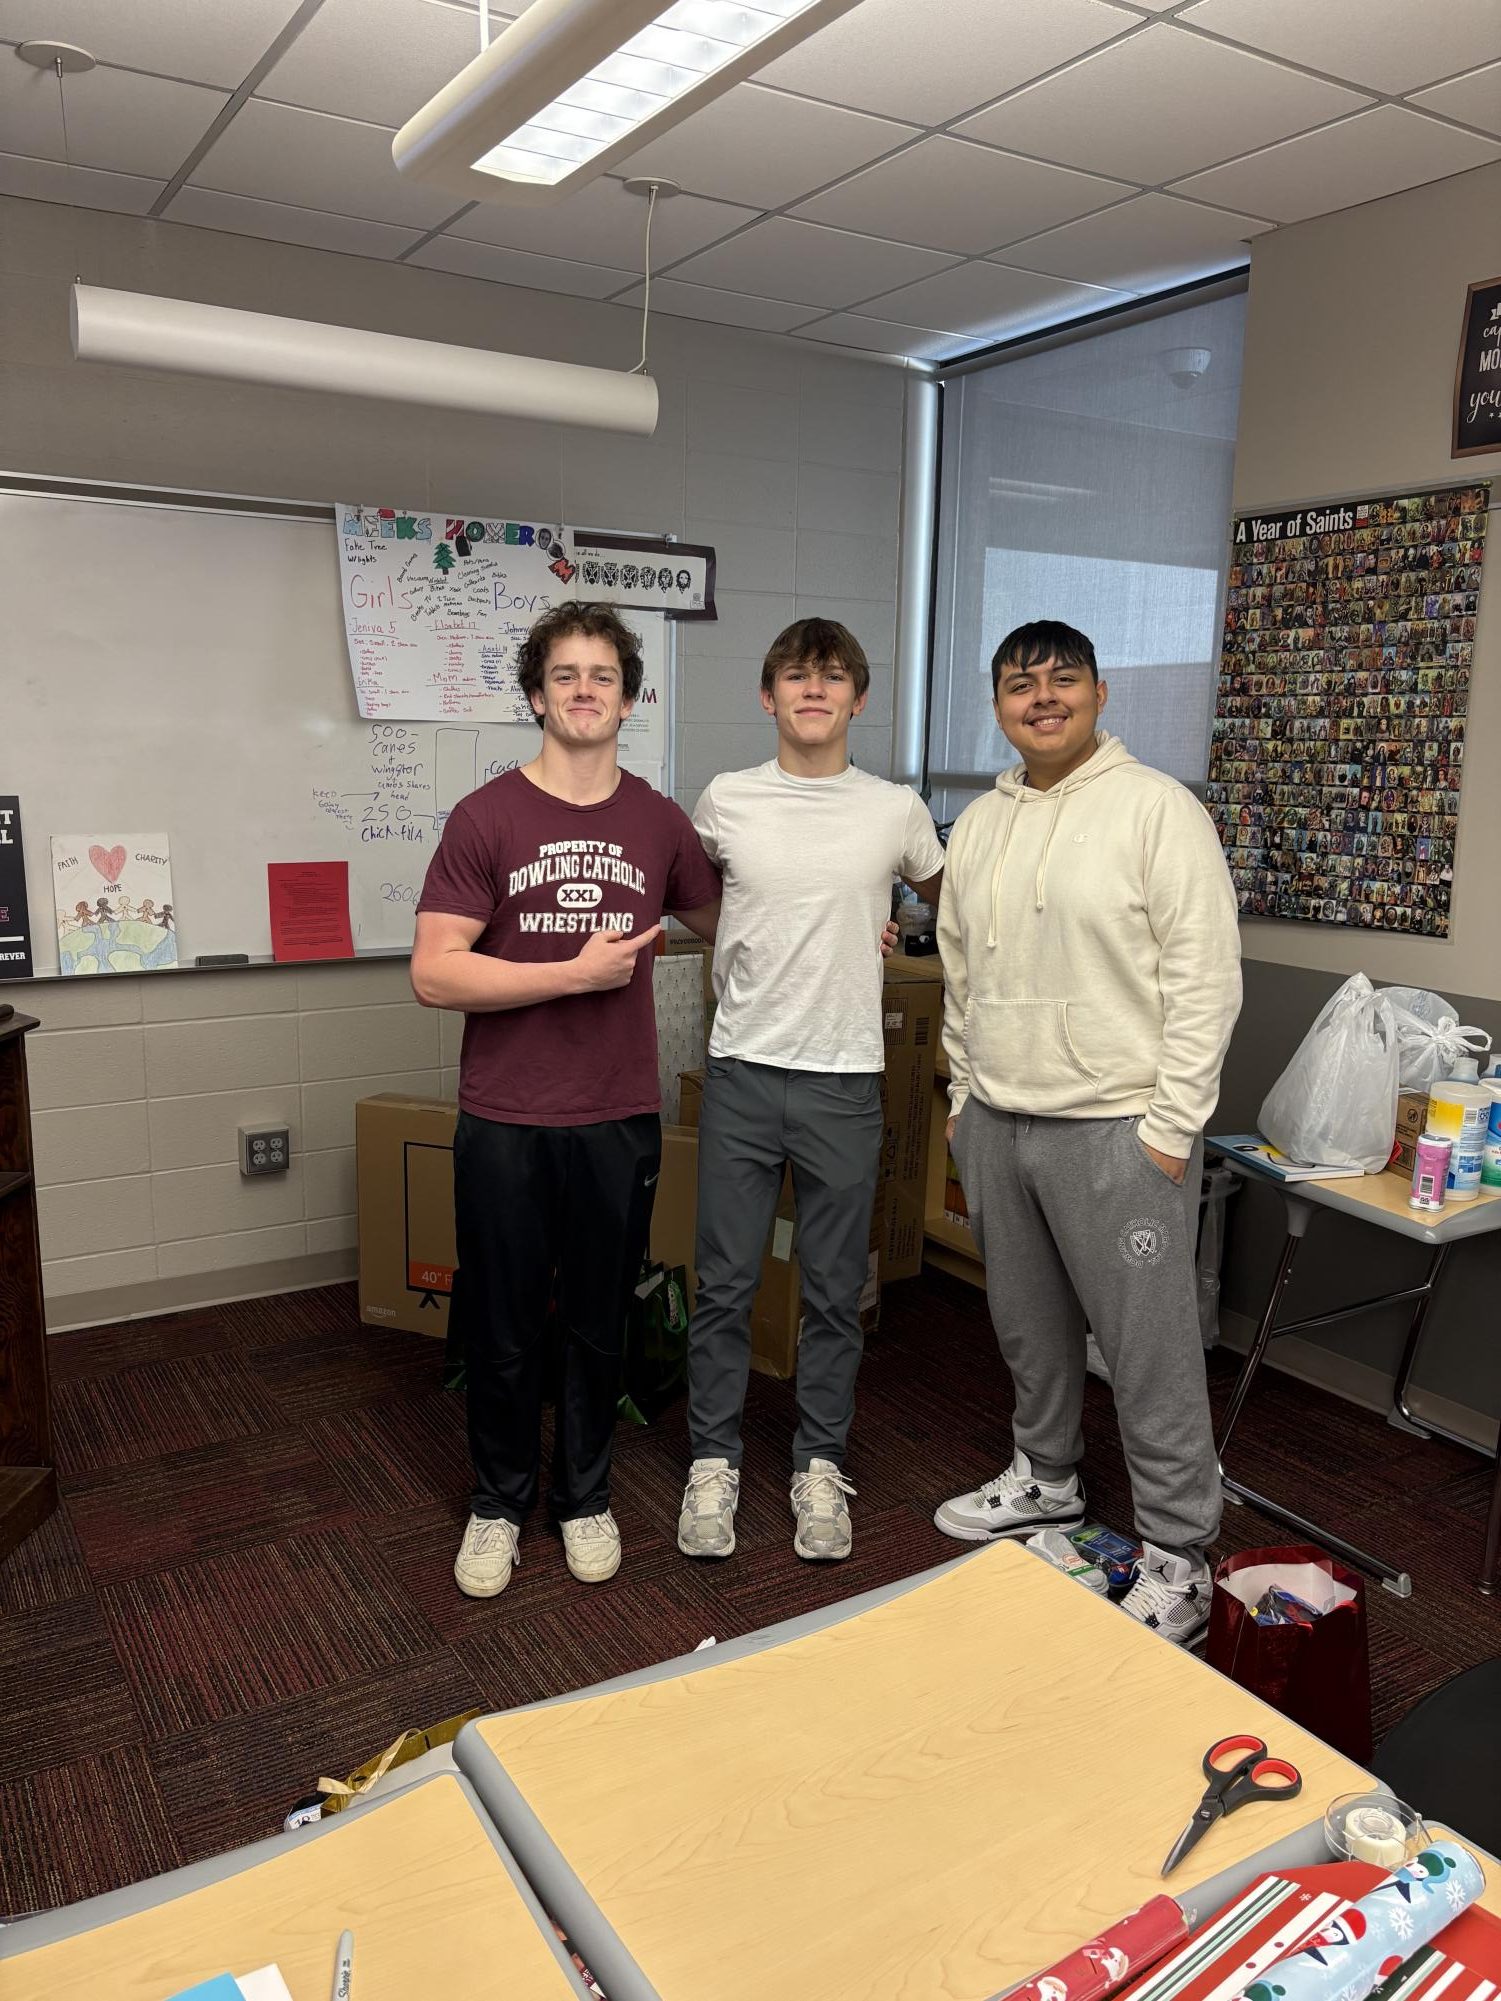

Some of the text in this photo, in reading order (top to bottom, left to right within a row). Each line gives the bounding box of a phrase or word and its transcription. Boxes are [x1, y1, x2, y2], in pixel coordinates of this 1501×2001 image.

[1479, 348, 1501, 372] MO
[1236, 521, 1246, 543] A
[1252, 519, 1283, 541] Year
[1287, 513, 1302, 537] of
[1305, 507, 1354, 535] Saints
[368, 540, 388, 551] Tree
[350, 574, 413, 610] Girls
[494, 582, 552, 612] Boys
[388, 621, 397, 634] 5
[0, 810, 14, 824] T
[0, 829, 14, 844] L
[539, 841, 623, 858] PROPERTY OF
[58, 857, 79, 871] FAITH
[135, 853, 169, 866] CHARITY
[508, 855, 646, 898] DOWLING CATHOLIC
[103, 883, 122, 893] HOPE
[560, 889, 597, 902] XXL
[519, 912, 634, 933] WRESTLING
[421, 1270, 442, 1284] 40"
[366, 1305, 396, 1317] amazon
